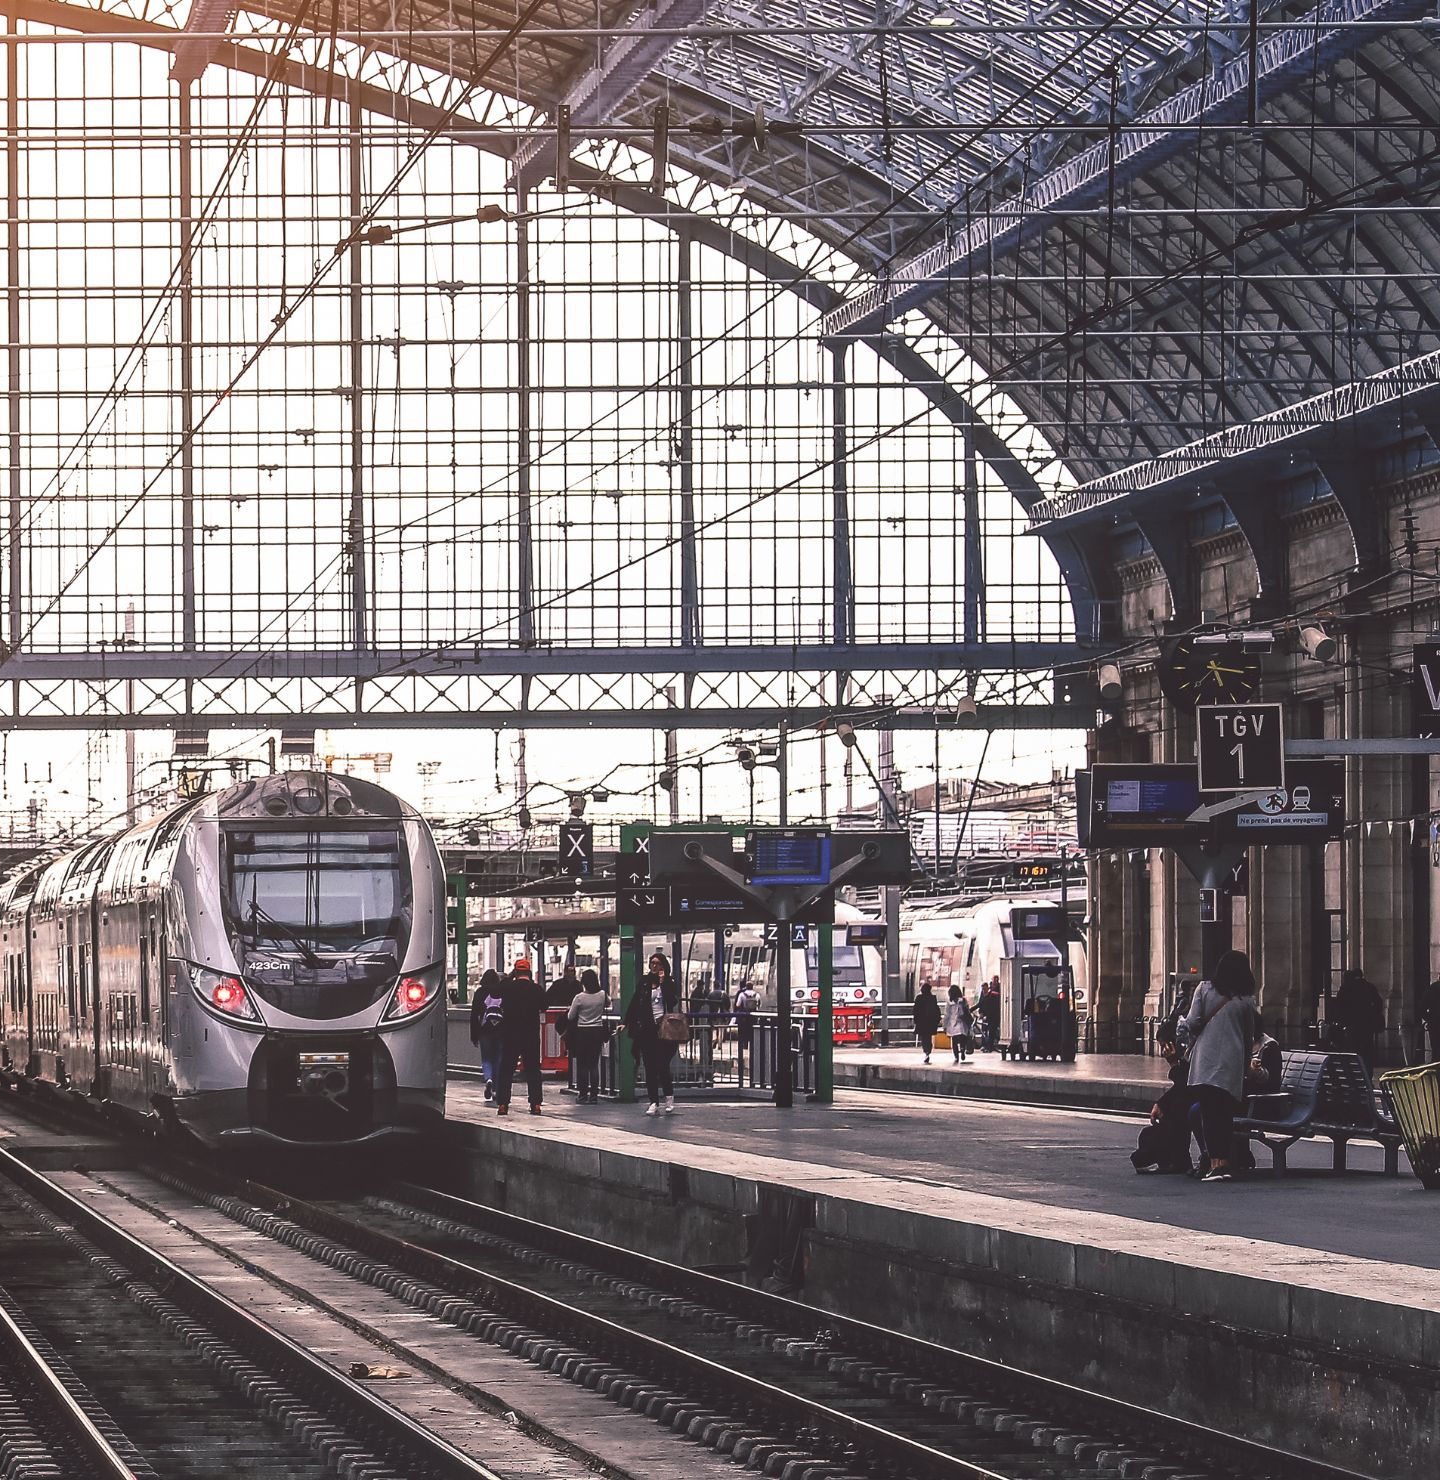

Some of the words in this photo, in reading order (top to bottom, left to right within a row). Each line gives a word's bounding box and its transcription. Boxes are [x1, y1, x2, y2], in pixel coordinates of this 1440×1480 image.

[1215, 714, 1264, 737] TGV
[1229, 743, 1244, 779] 1
[1098, 803, 1103, 811] 3
[1334, 799, 1340, 807] 2
[1250, 817, 1269, 825] prend
[1292, 817, 1324, 825] voyageurs
[567, 834, 586, 857] X
[635, 837, 649, 853] X
[1232, 864, 1243, 882] Y
[767, 926, 778, 940] Z
[795, 929, 805, 940] A
